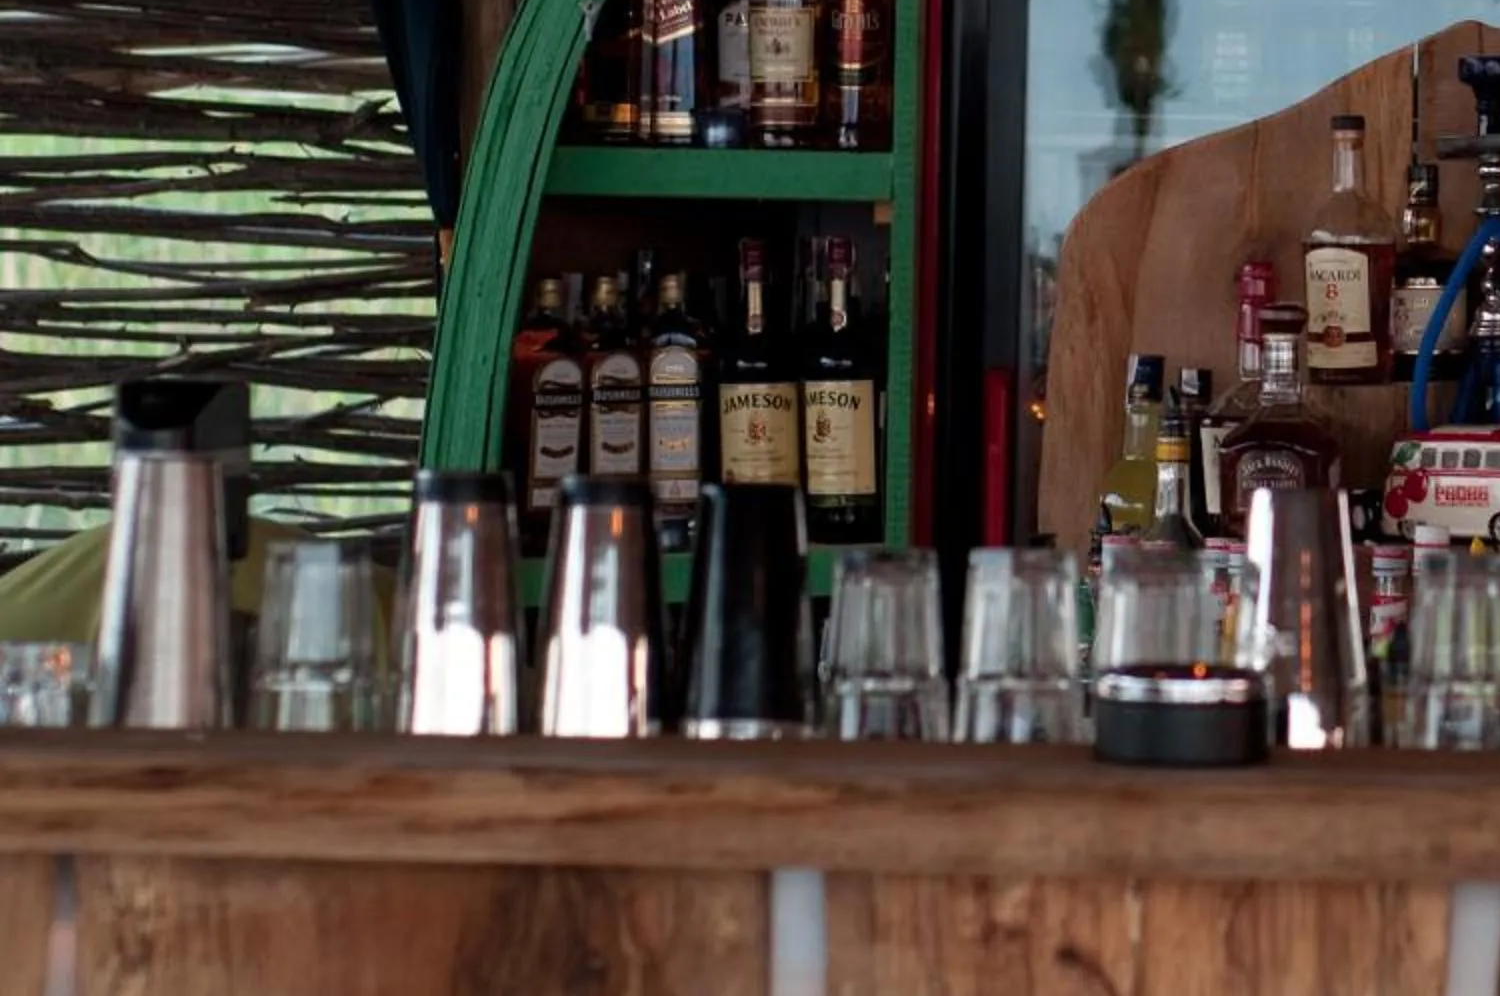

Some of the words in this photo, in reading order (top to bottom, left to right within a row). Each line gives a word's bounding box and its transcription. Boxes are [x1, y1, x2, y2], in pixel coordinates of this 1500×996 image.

[659, 0, 693, 21] Label
[1325, 283, 1338, 300] 8
[723, 393, 793, 414] JAMESON
